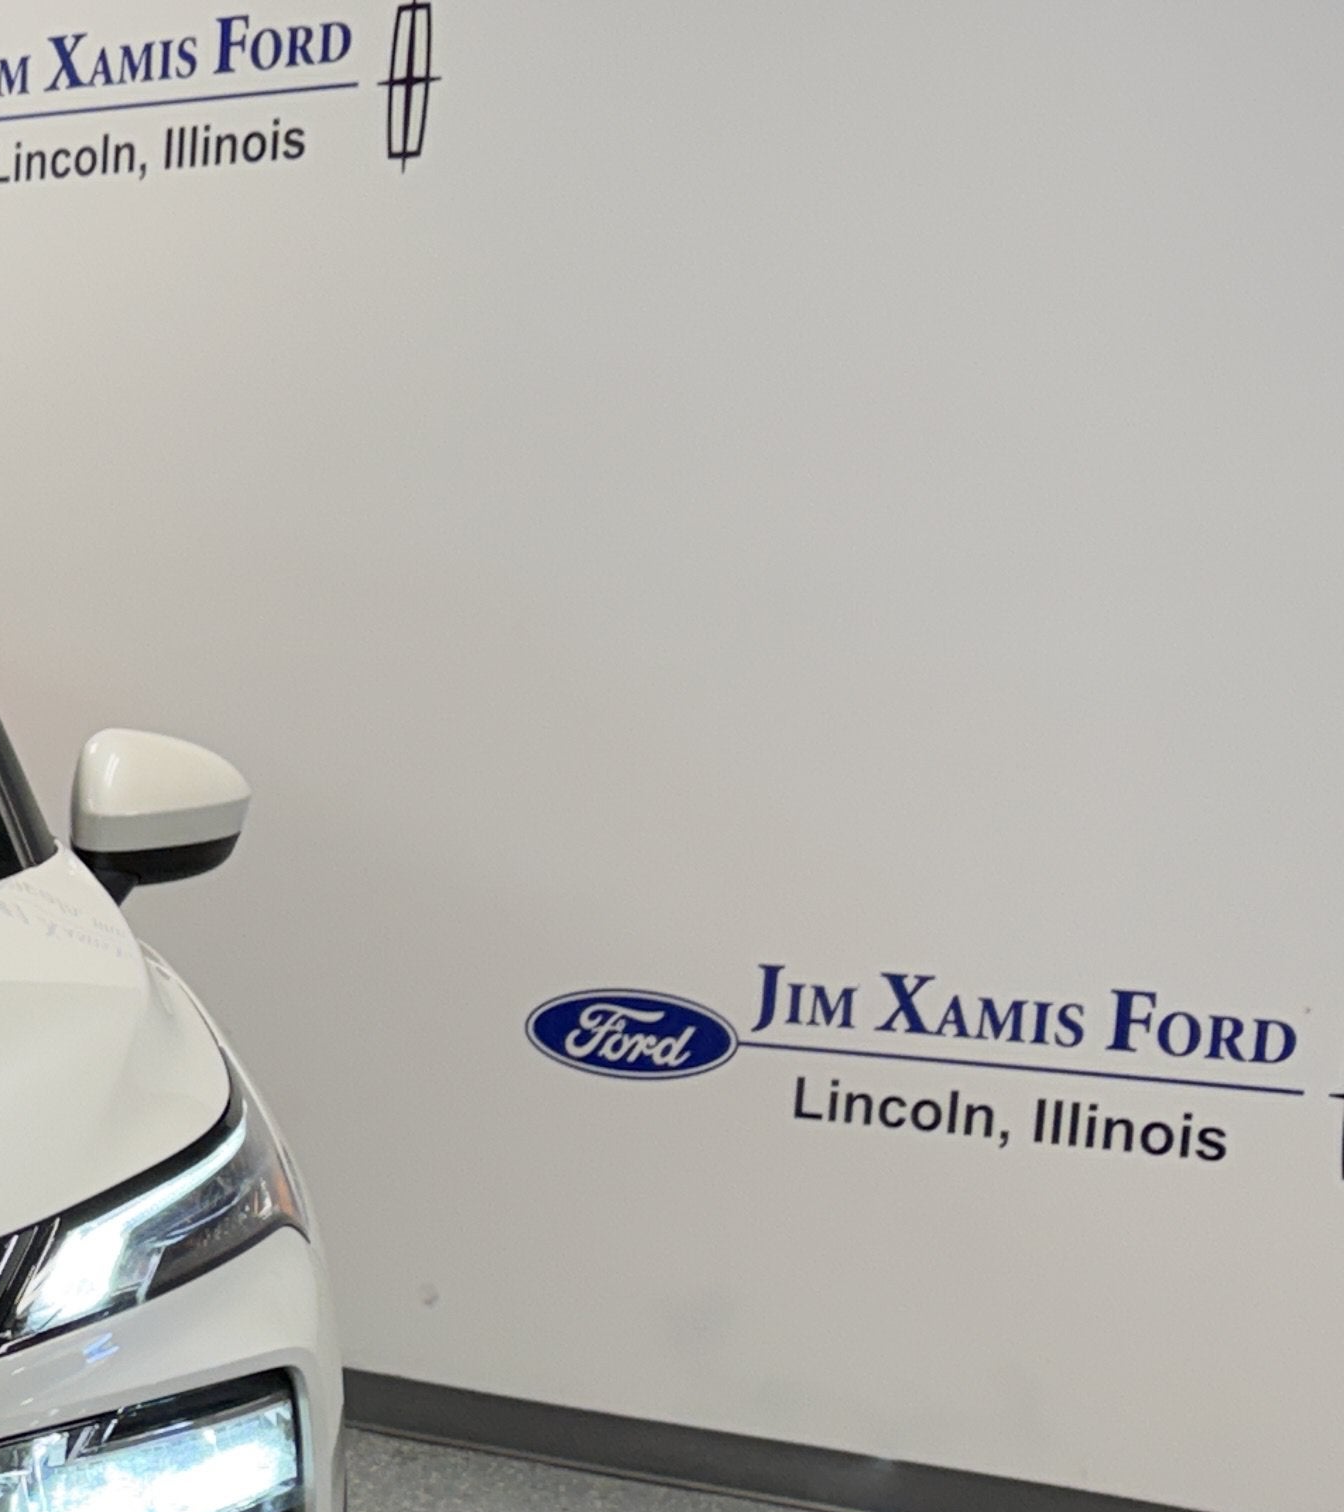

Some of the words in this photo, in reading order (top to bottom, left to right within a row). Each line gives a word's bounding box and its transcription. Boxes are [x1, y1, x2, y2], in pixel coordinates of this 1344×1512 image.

[163, 119, 305, 171] Illinois
[564, 1004, 692, 1068] Ford
[793, 1076, 1010, 1148] Lincoln,
[1032, 1098, 1227, 1161] Illinois
